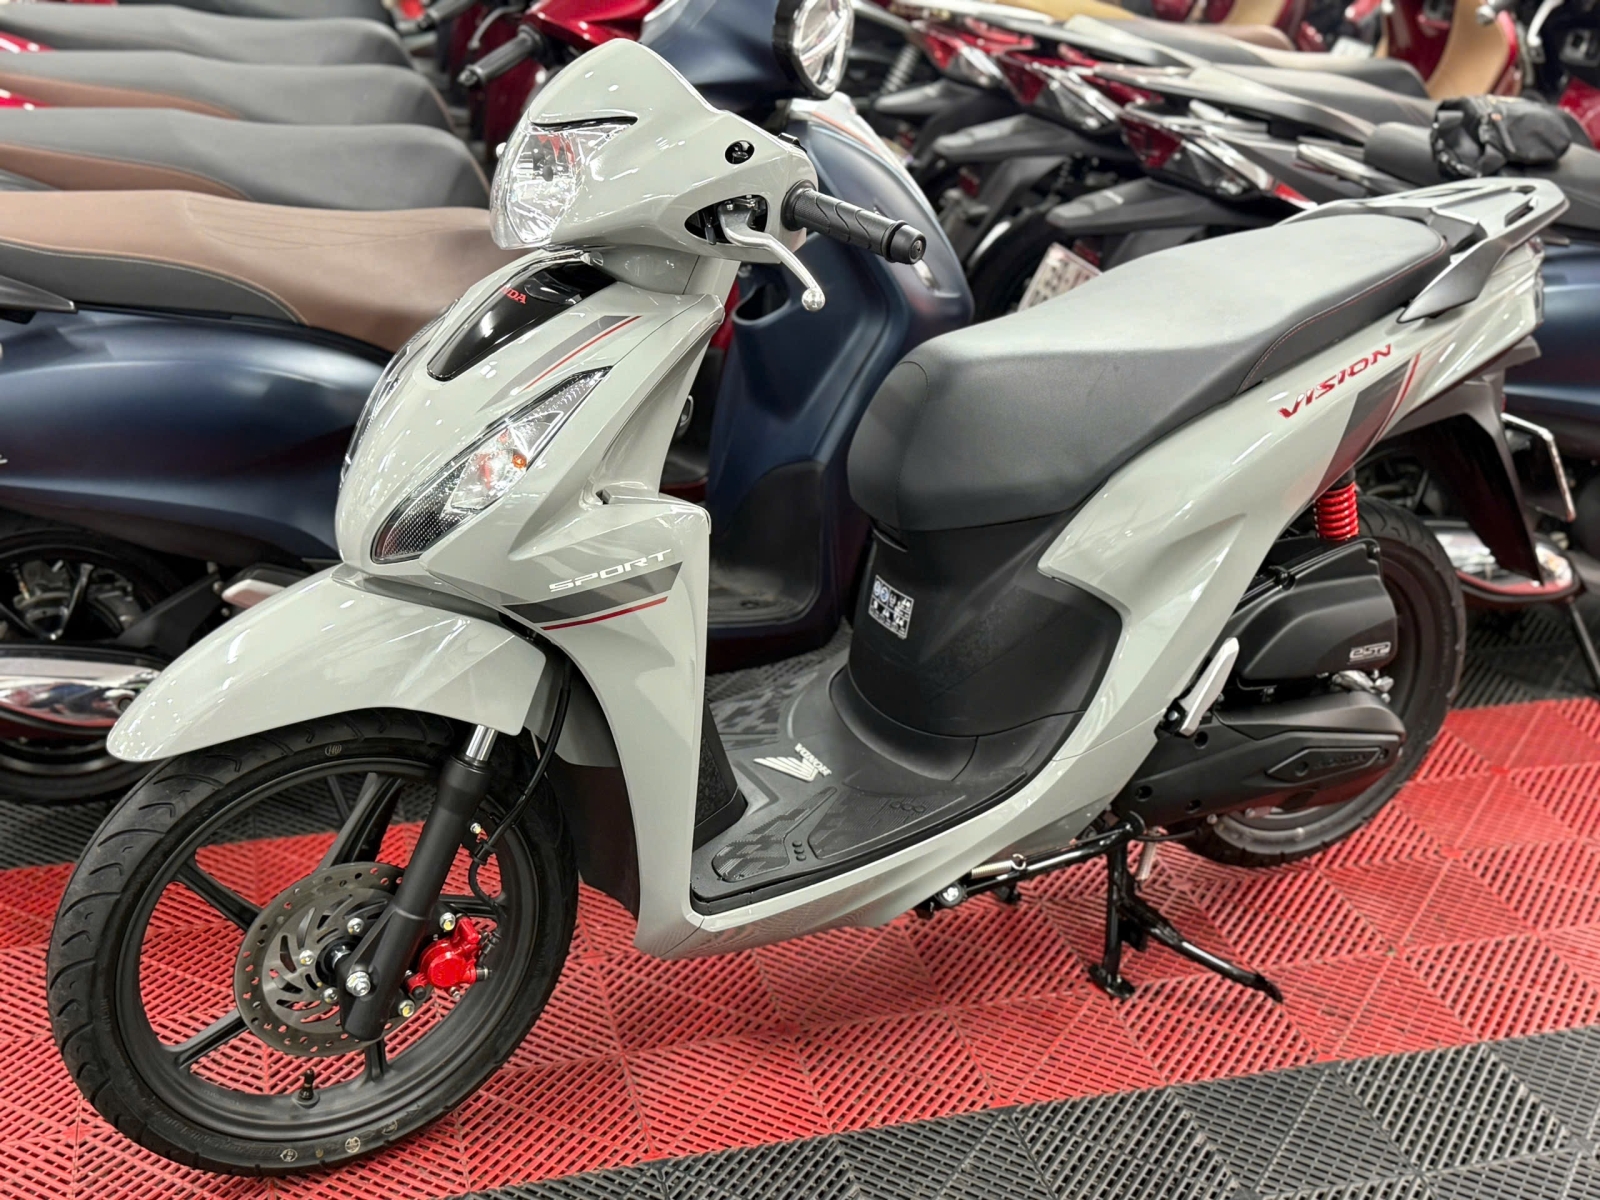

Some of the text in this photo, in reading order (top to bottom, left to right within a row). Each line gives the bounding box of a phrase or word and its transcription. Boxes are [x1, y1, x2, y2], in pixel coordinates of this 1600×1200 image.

[1278, 343, 1391, 418] VISION
[549, 549, 672, 592] SPORT
[794, 743, 832, 777] HONDA
